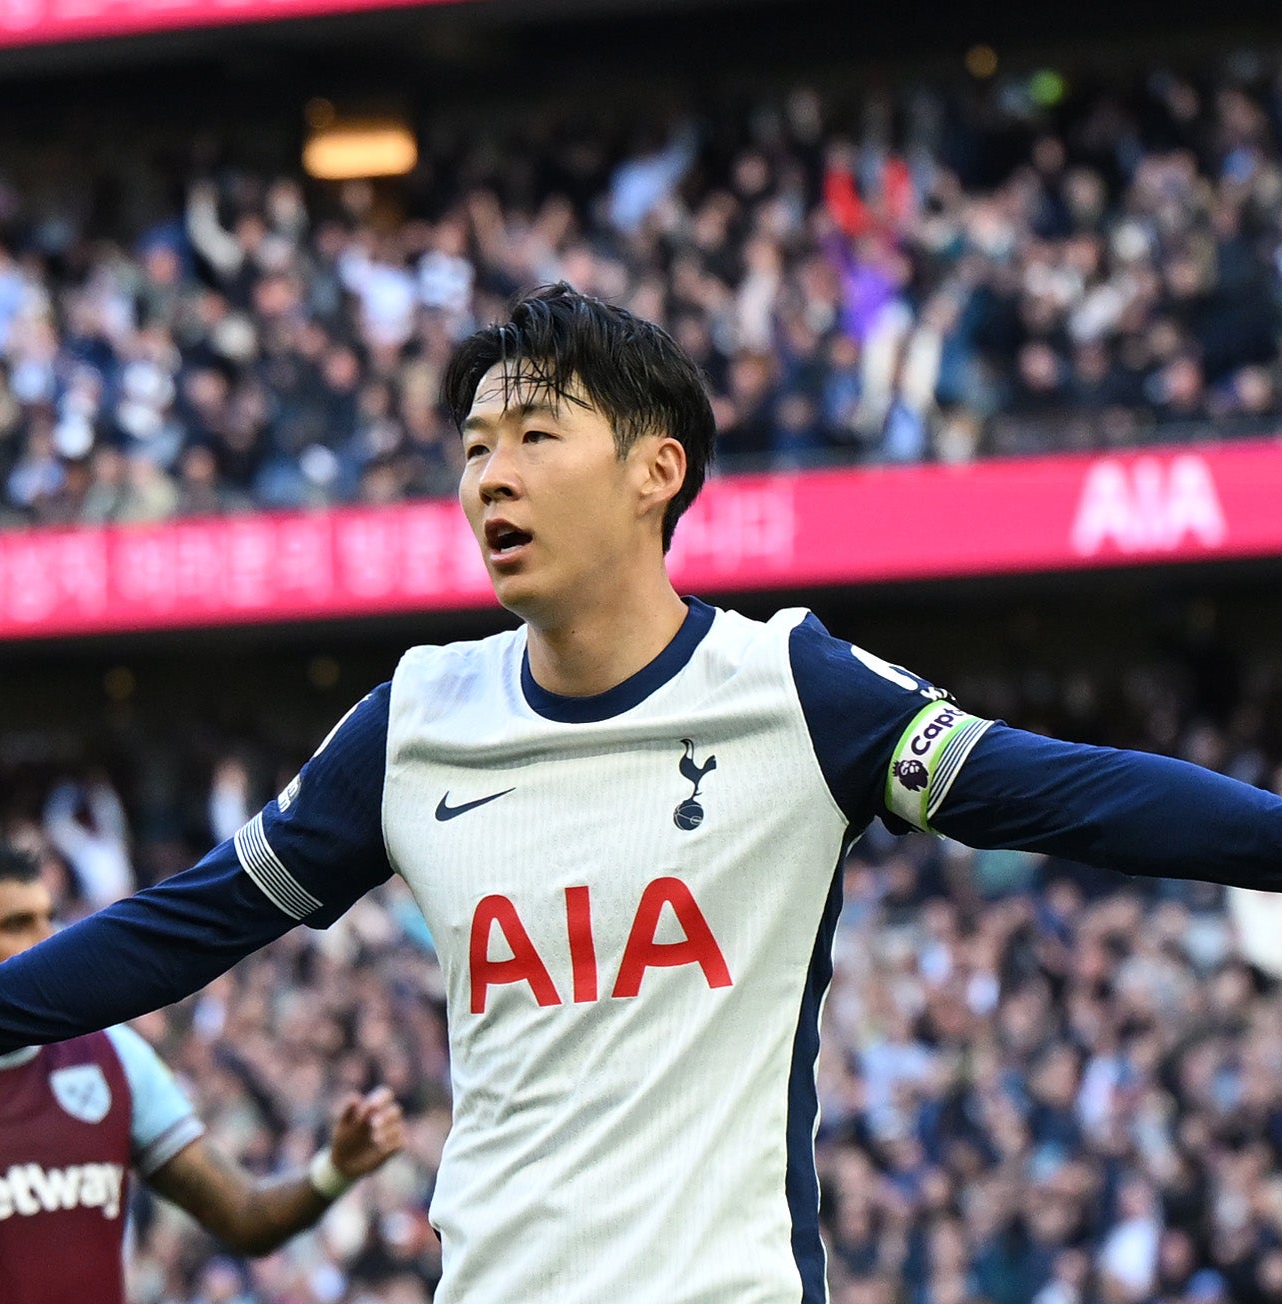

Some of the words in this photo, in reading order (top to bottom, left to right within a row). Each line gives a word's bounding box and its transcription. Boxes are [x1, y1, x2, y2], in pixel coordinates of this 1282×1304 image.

[1071, 455, 1227, 558] AIA
[911, 707, 964, 756] Capt
[470, 877, 733, 1014] AIA
